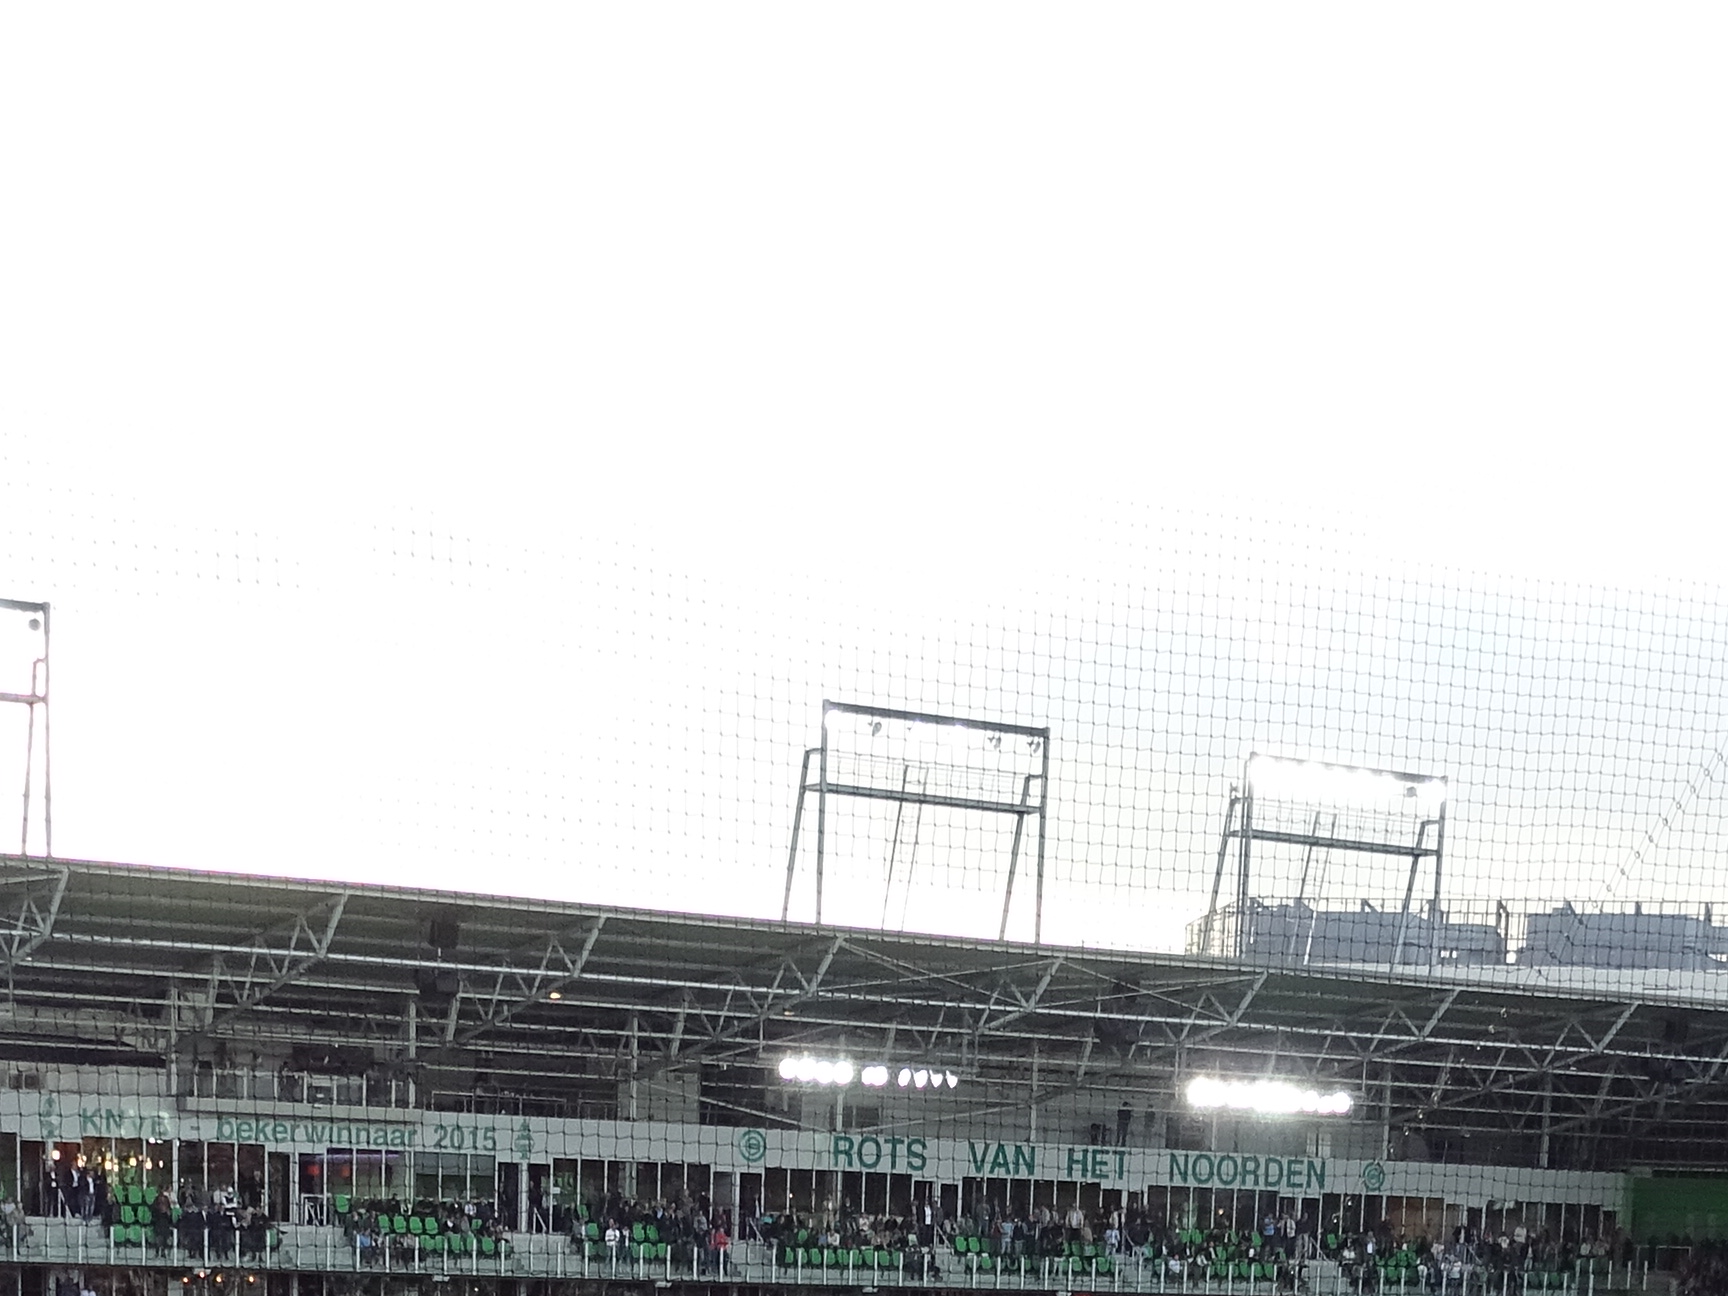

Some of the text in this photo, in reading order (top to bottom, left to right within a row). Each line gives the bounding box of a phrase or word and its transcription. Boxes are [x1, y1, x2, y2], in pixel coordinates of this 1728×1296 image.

[81, 1105, 171, 1138] KNVB
[432, 1122, 498, 1152] 2015
[831, 1135, 1326, 1190] ROTS VAN HET NOORDEN
